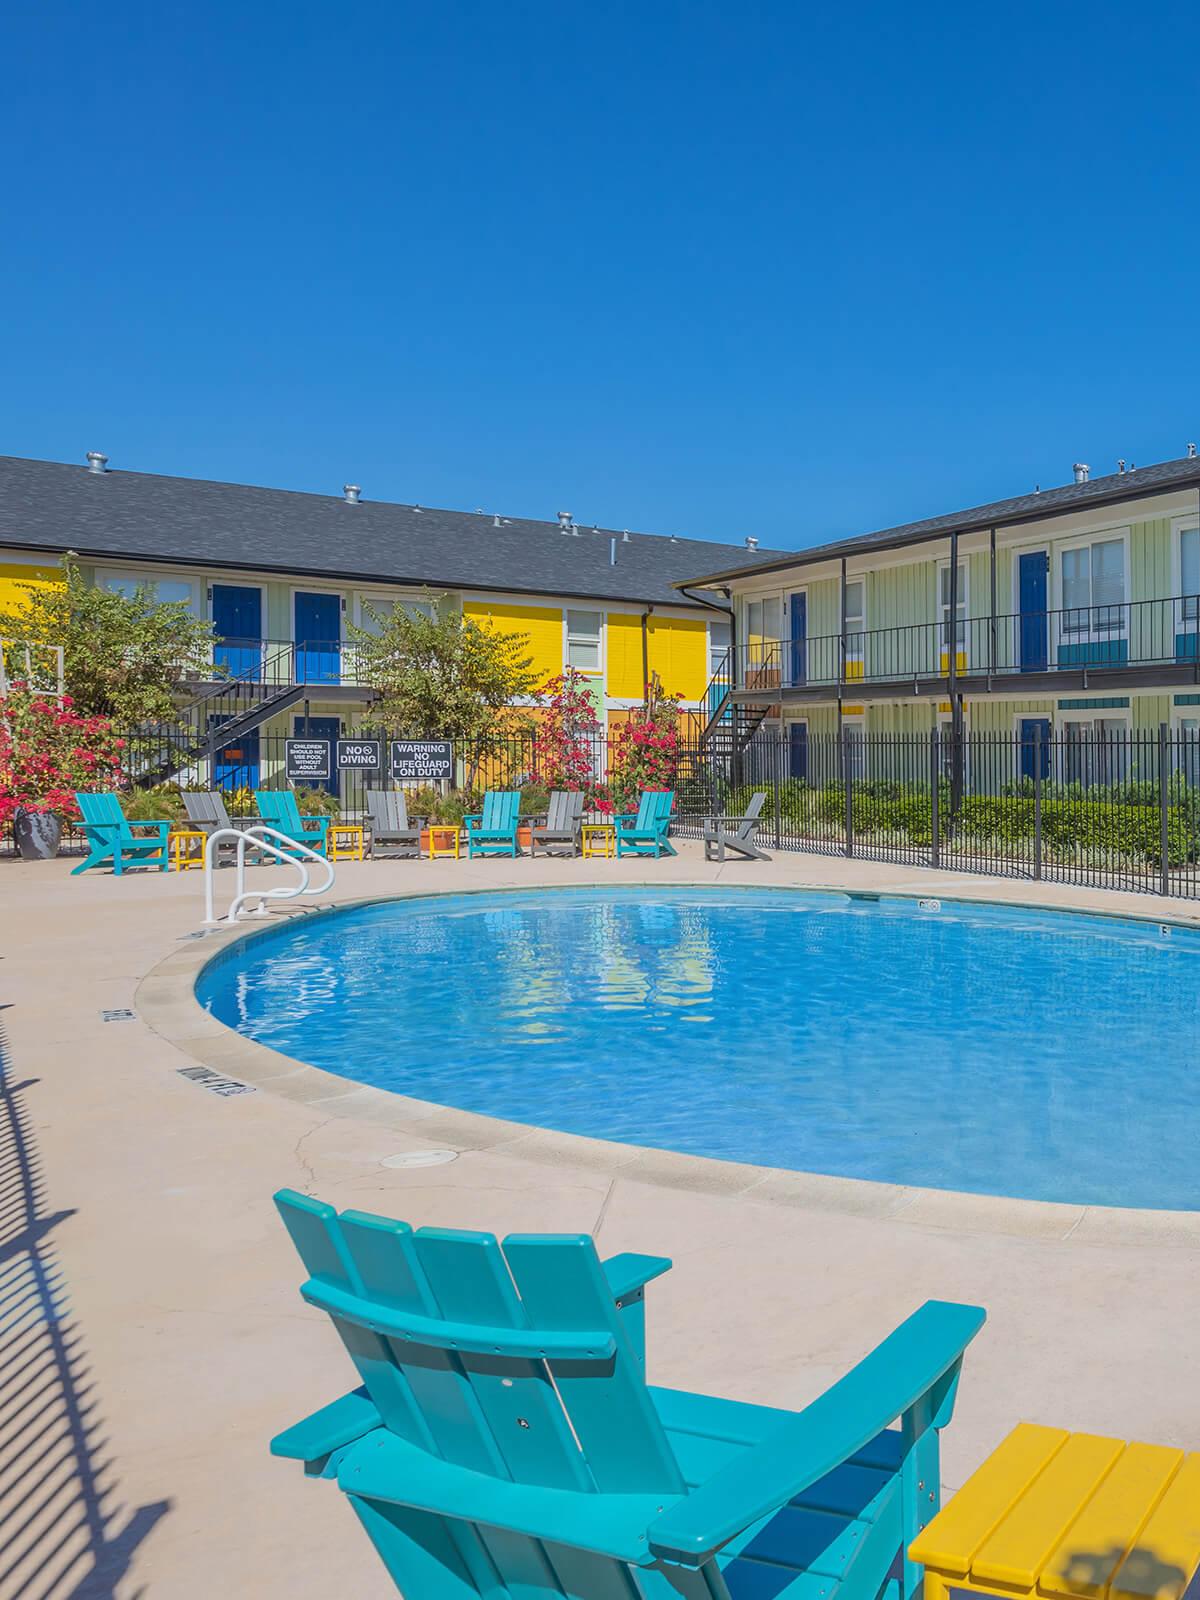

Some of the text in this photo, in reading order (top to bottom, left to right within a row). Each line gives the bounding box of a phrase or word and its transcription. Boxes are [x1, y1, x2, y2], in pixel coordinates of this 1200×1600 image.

[346, 746, 362, 754] NO
[398, 744, 445, 752] WARNING
[340, 756, 376, 764] DIVING
